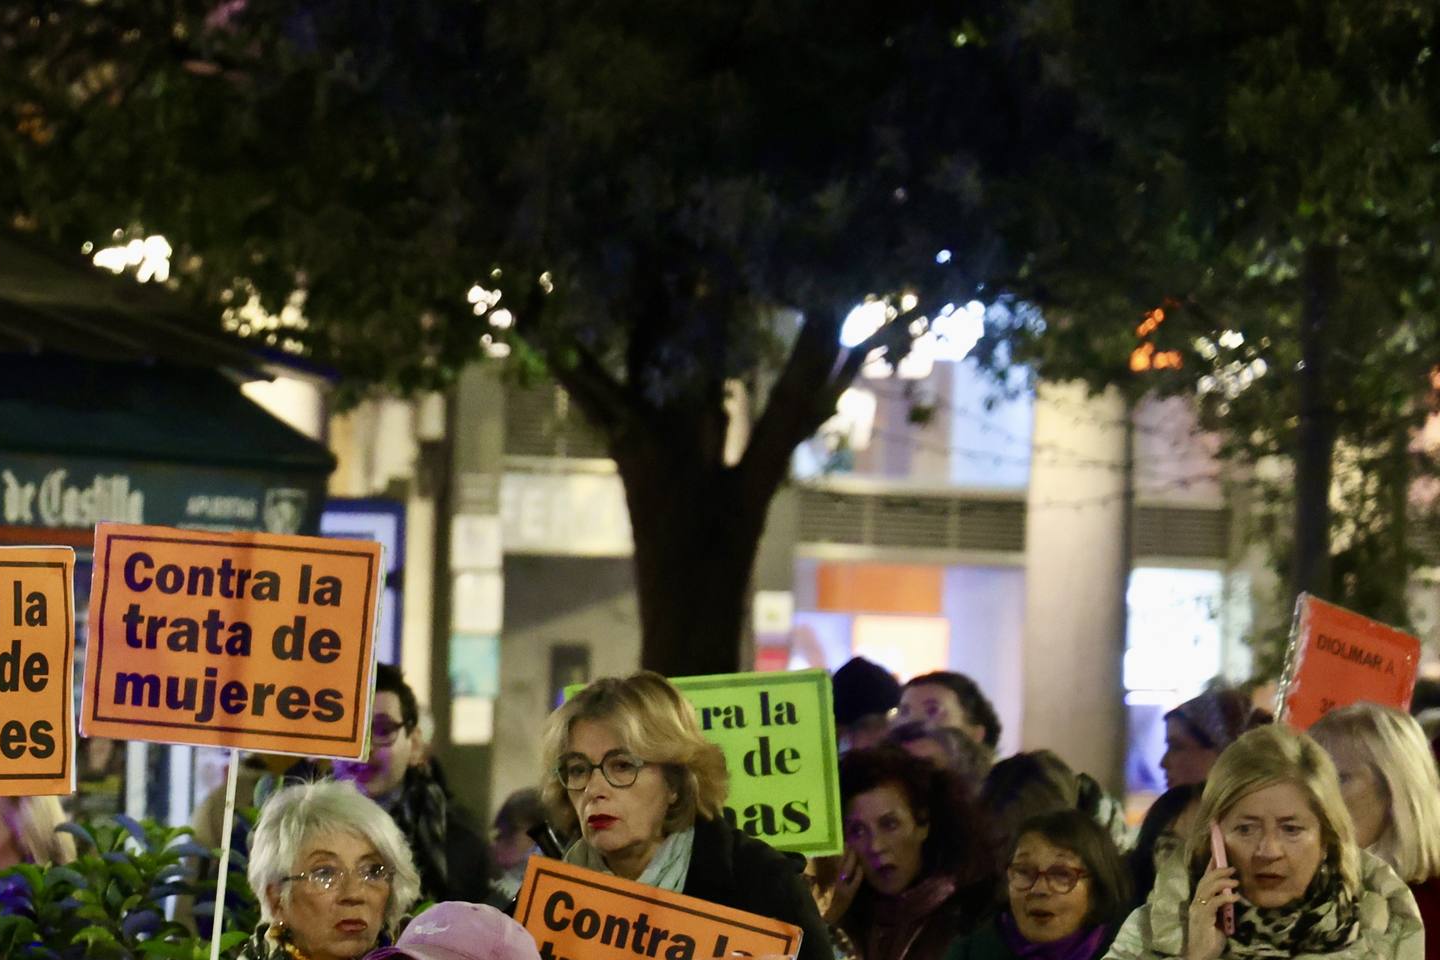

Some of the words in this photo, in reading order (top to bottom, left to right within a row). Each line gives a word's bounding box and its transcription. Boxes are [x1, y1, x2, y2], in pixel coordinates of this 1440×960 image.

[2, 469, 35, 523] de
[39, 468, 145, 527] Castilla
[13, 580, 48, 627] la
[124, 552, 281, 601] Contra
[298, 564, 343, 607] la
[123, 604, 252, 657] trata
[271, 615, 342, 664] de
[113, 667, 345, 723] mujeres
[697, 704, 749, 731] ra
[758, 691, 799, 727] la
[743, 736, 802, 777] de
[712, 934, 754, 958] l
